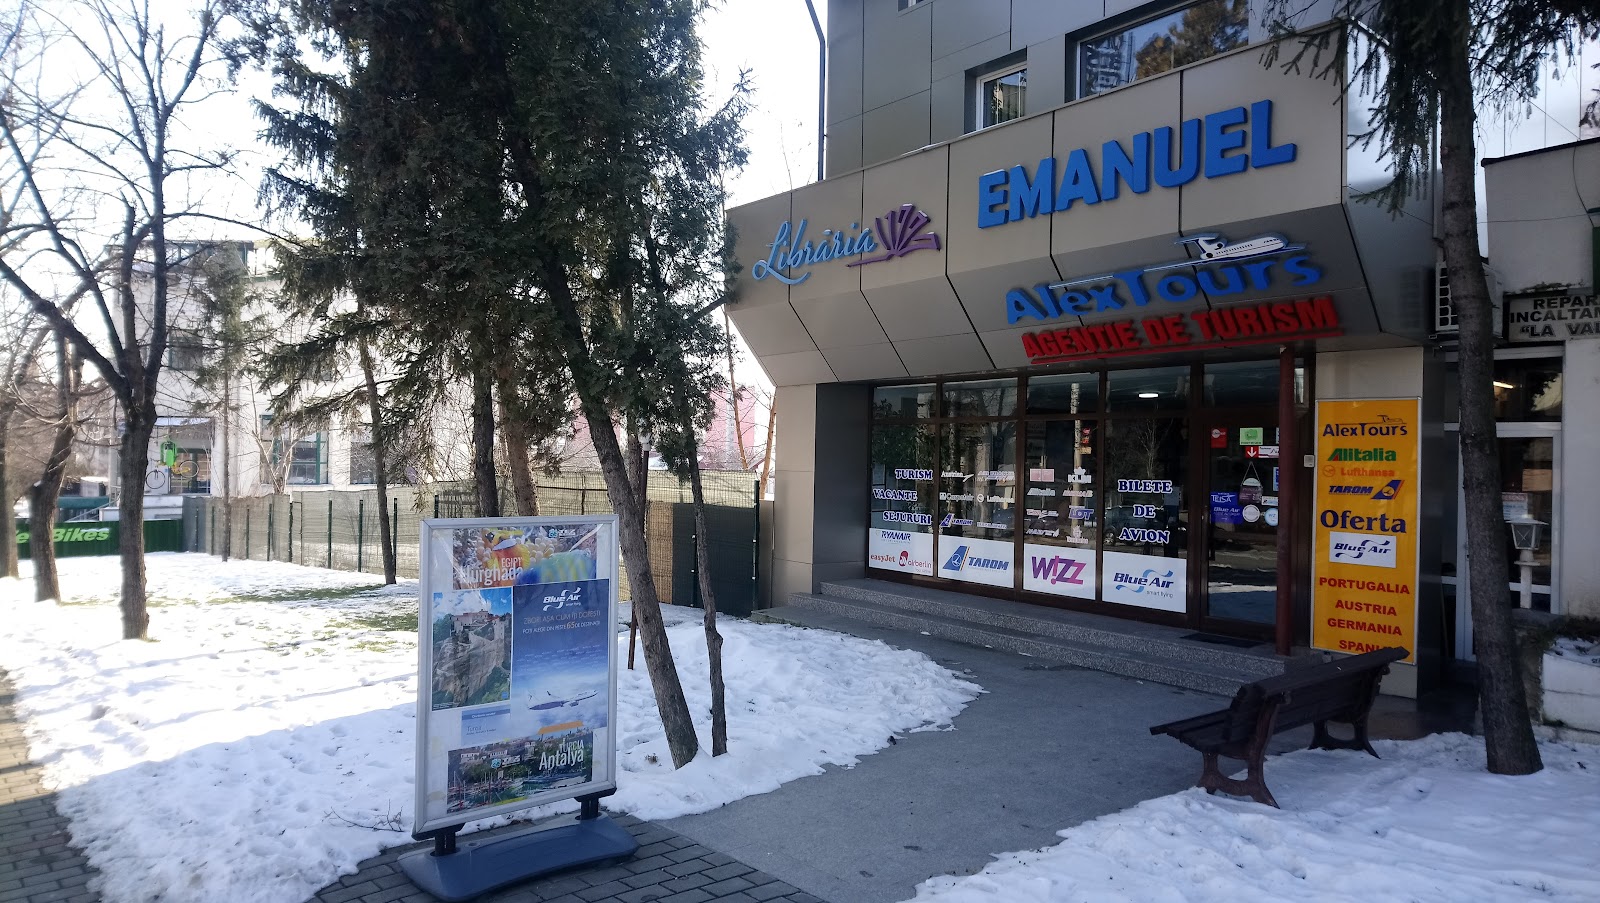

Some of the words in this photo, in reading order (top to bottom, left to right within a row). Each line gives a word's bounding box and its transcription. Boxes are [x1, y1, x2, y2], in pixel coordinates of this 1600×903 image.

[978, 99, 1297, 229] EMANUEL
[1006, 254, 1322, 325] AlexTours
[1021, 319, 1141, 358] AGENTIE
[1142, 313, 1193, 346] DE
[1191, 294, 1340, 341] TURISM
[1322, 423, 1408, 437] AlexTours
[1327, 448, 1397, 461] Alitalia
[895, 468, 933, 480] TURISM
[1341, 467, 1395, 477] Lufthansa
[1118, 479, 1172, 494] BILETE
[1329, 485, 1374, 494] TAROM
[873, 488, 918, 501] VACANTE
[883, 511, 932, 525] SEJURURI
[1133, 504, 1156, 518] DE
[1320, 509, 1407, 534] Oferta
[53, 528, 110, 542] Bikes
[881, 530, 911, 541] RYANAIR
[1119, 528, 1171, 544] AVION
[1334, 542, 1366, 552] Blue
[1367, 545, 1391, 554] Air
[501, 556, 523, 568] EGIPT
[870, 554, 896, 563] easyJet
[968, 556, 1009, 571] TAROM
[1113, 572, 1148, 586] Blue
[1149, 577, 1174, 589] Air
[1319, 577, 1410, 595] PORTUGALIA
[543, 595, 565, 603] Blue
[566, 594, 581, 602] Air
[1335, 599, 1397, 616] AUSTRIA
[566, 621, 575, 630] 65
[1327, 617, 1402, 636] GERMANIA
[1339, 639, 1381, 652] SPANI
[538, 748, 584, 771] Antalya
